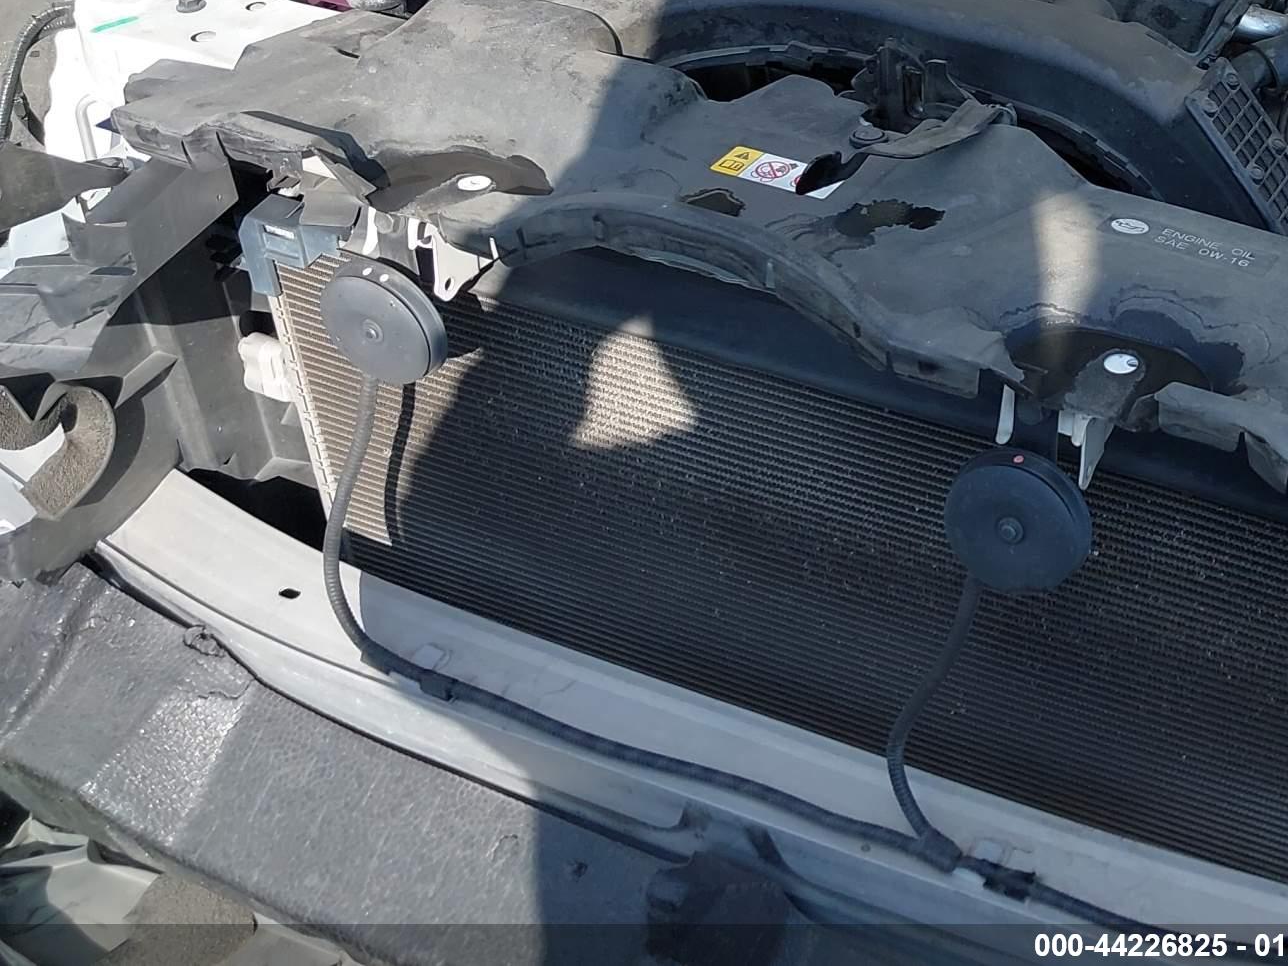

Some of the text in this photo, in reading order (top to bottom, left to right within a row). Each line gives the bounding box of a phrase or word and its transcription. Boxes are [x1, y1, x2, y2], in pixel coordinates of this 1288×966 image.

[1154, 236, 1250, 267] SAE 0W-16
[1162, 228, 1256, 260] ENGINE OIL
